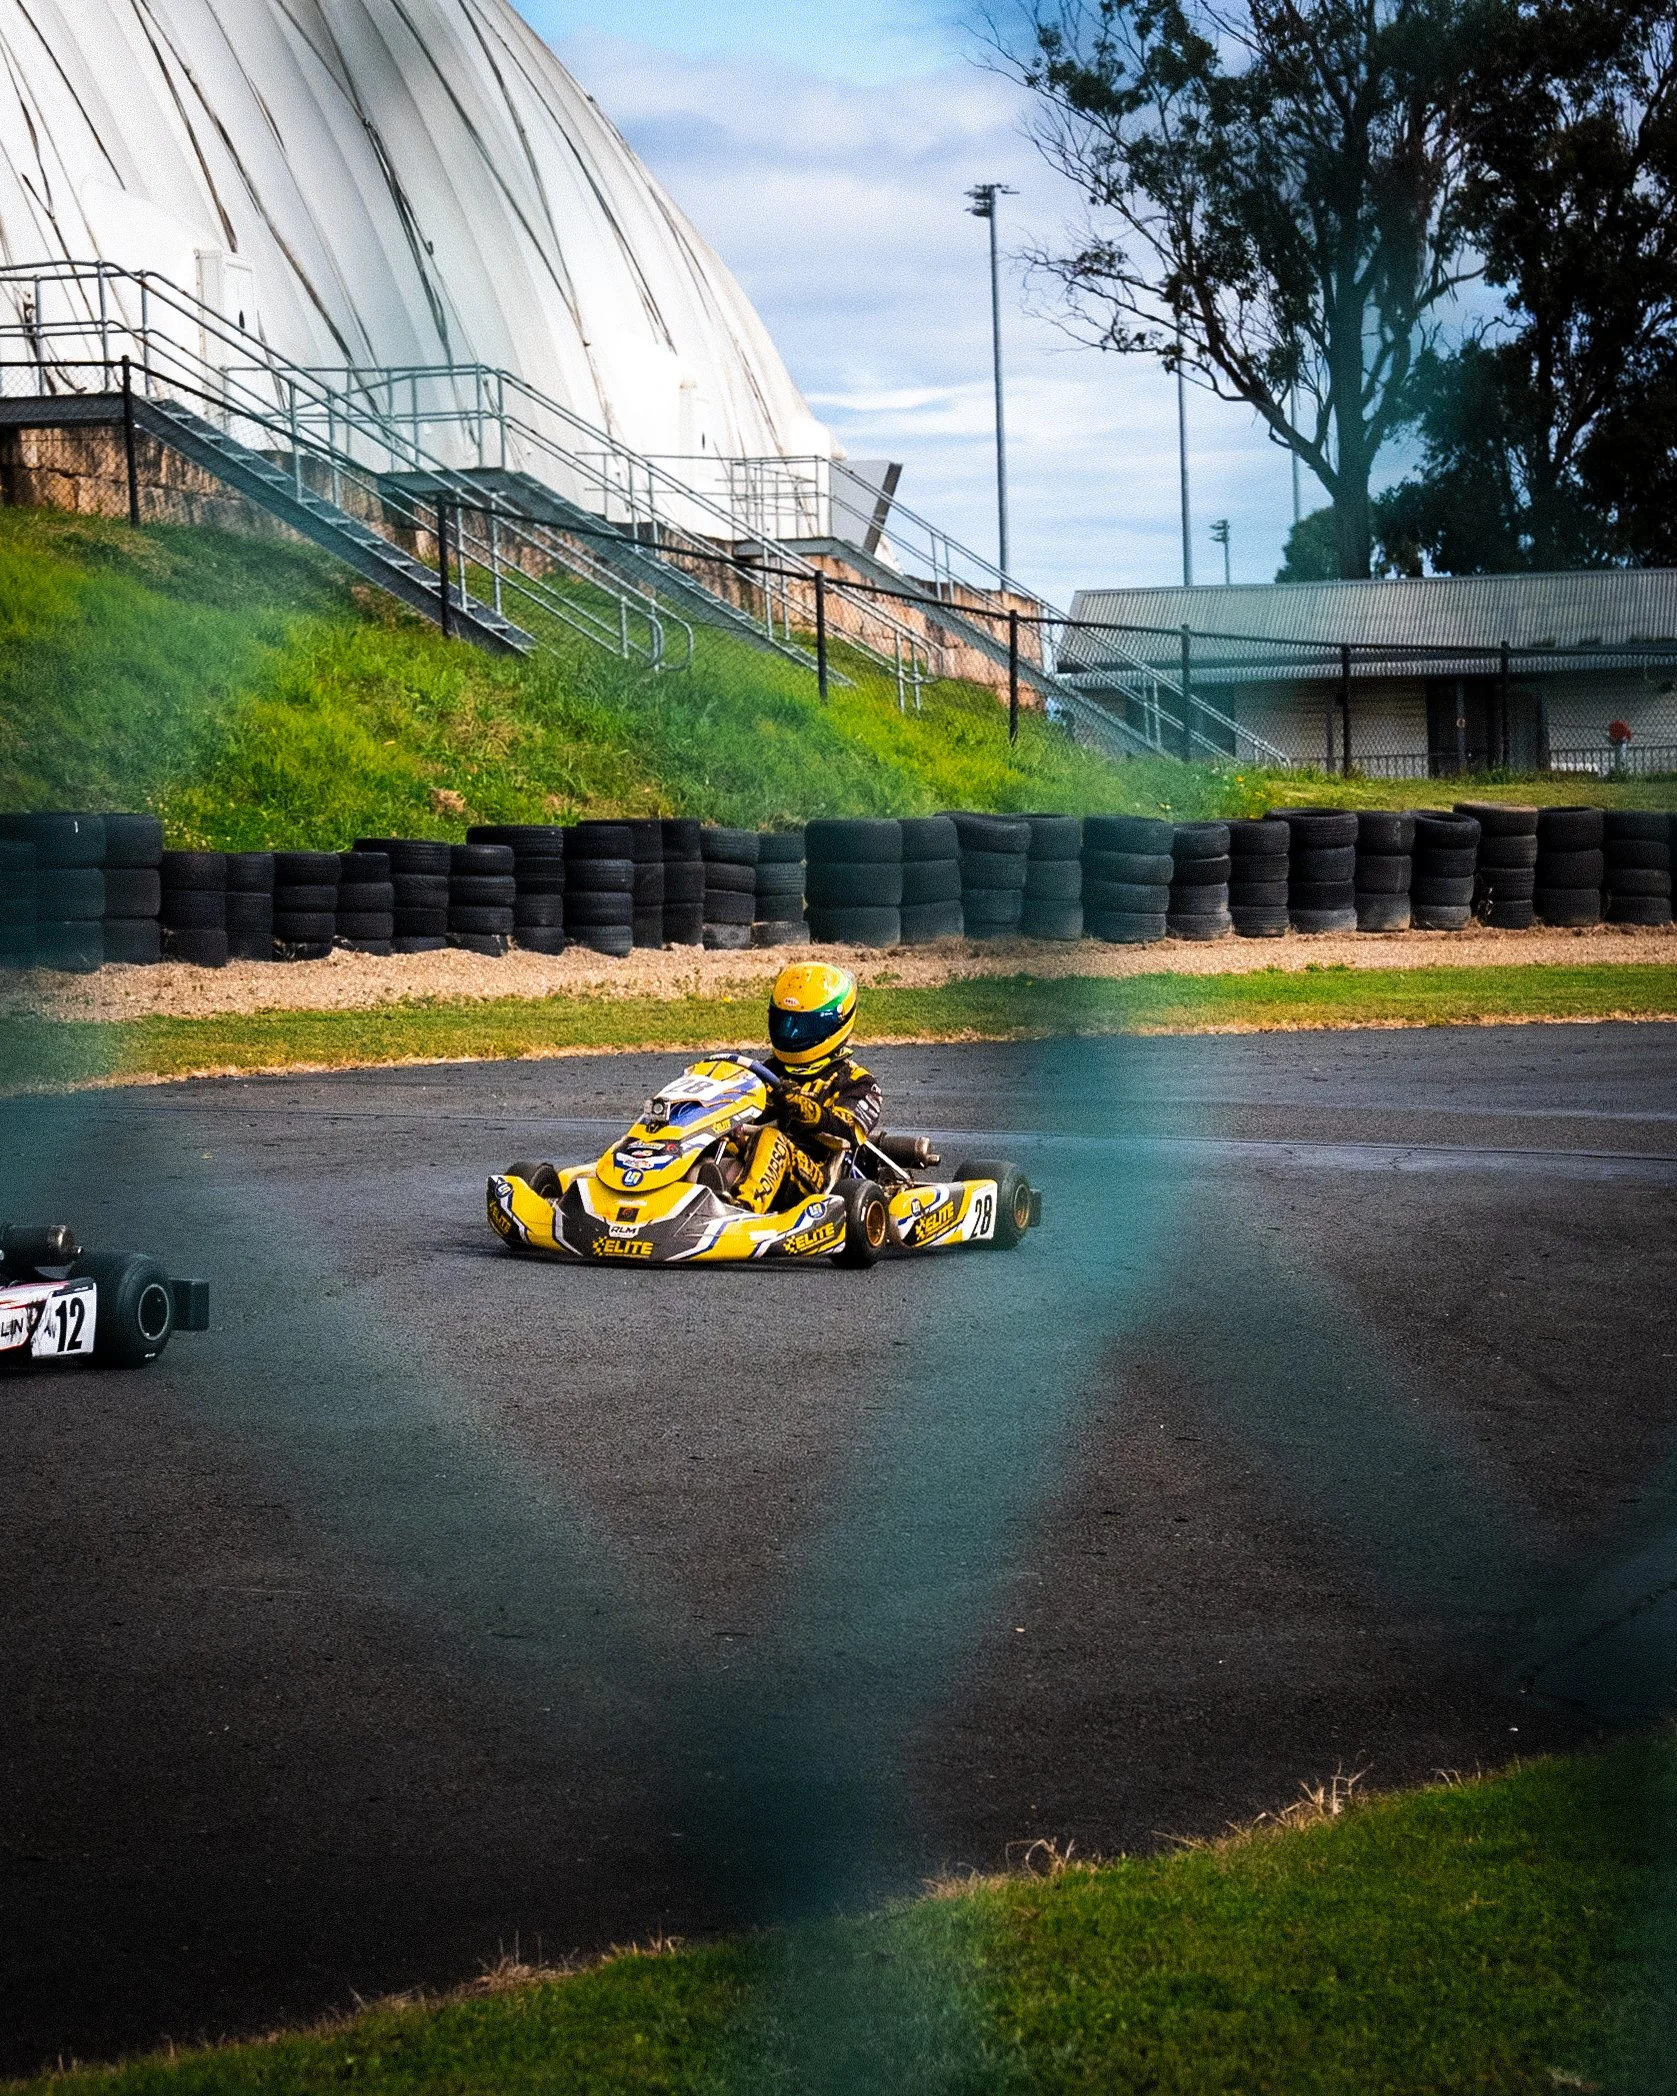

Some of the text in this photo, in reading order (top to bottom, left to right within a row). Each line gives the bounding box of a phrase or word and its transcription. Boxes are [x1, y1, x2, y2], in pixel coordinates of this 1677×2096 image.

[663, 1079, 714, 1094] 28
[610, 1226, 637, 1234] RLM
[924, 1201, 954, 1235] ELITE
[970, 1194, 993, 1239] 28
[603, 1239, 655, 1255] ELITE
[795, 1222, 835, 1249] ELITE
[55, 1297, 85, 1353] 12
